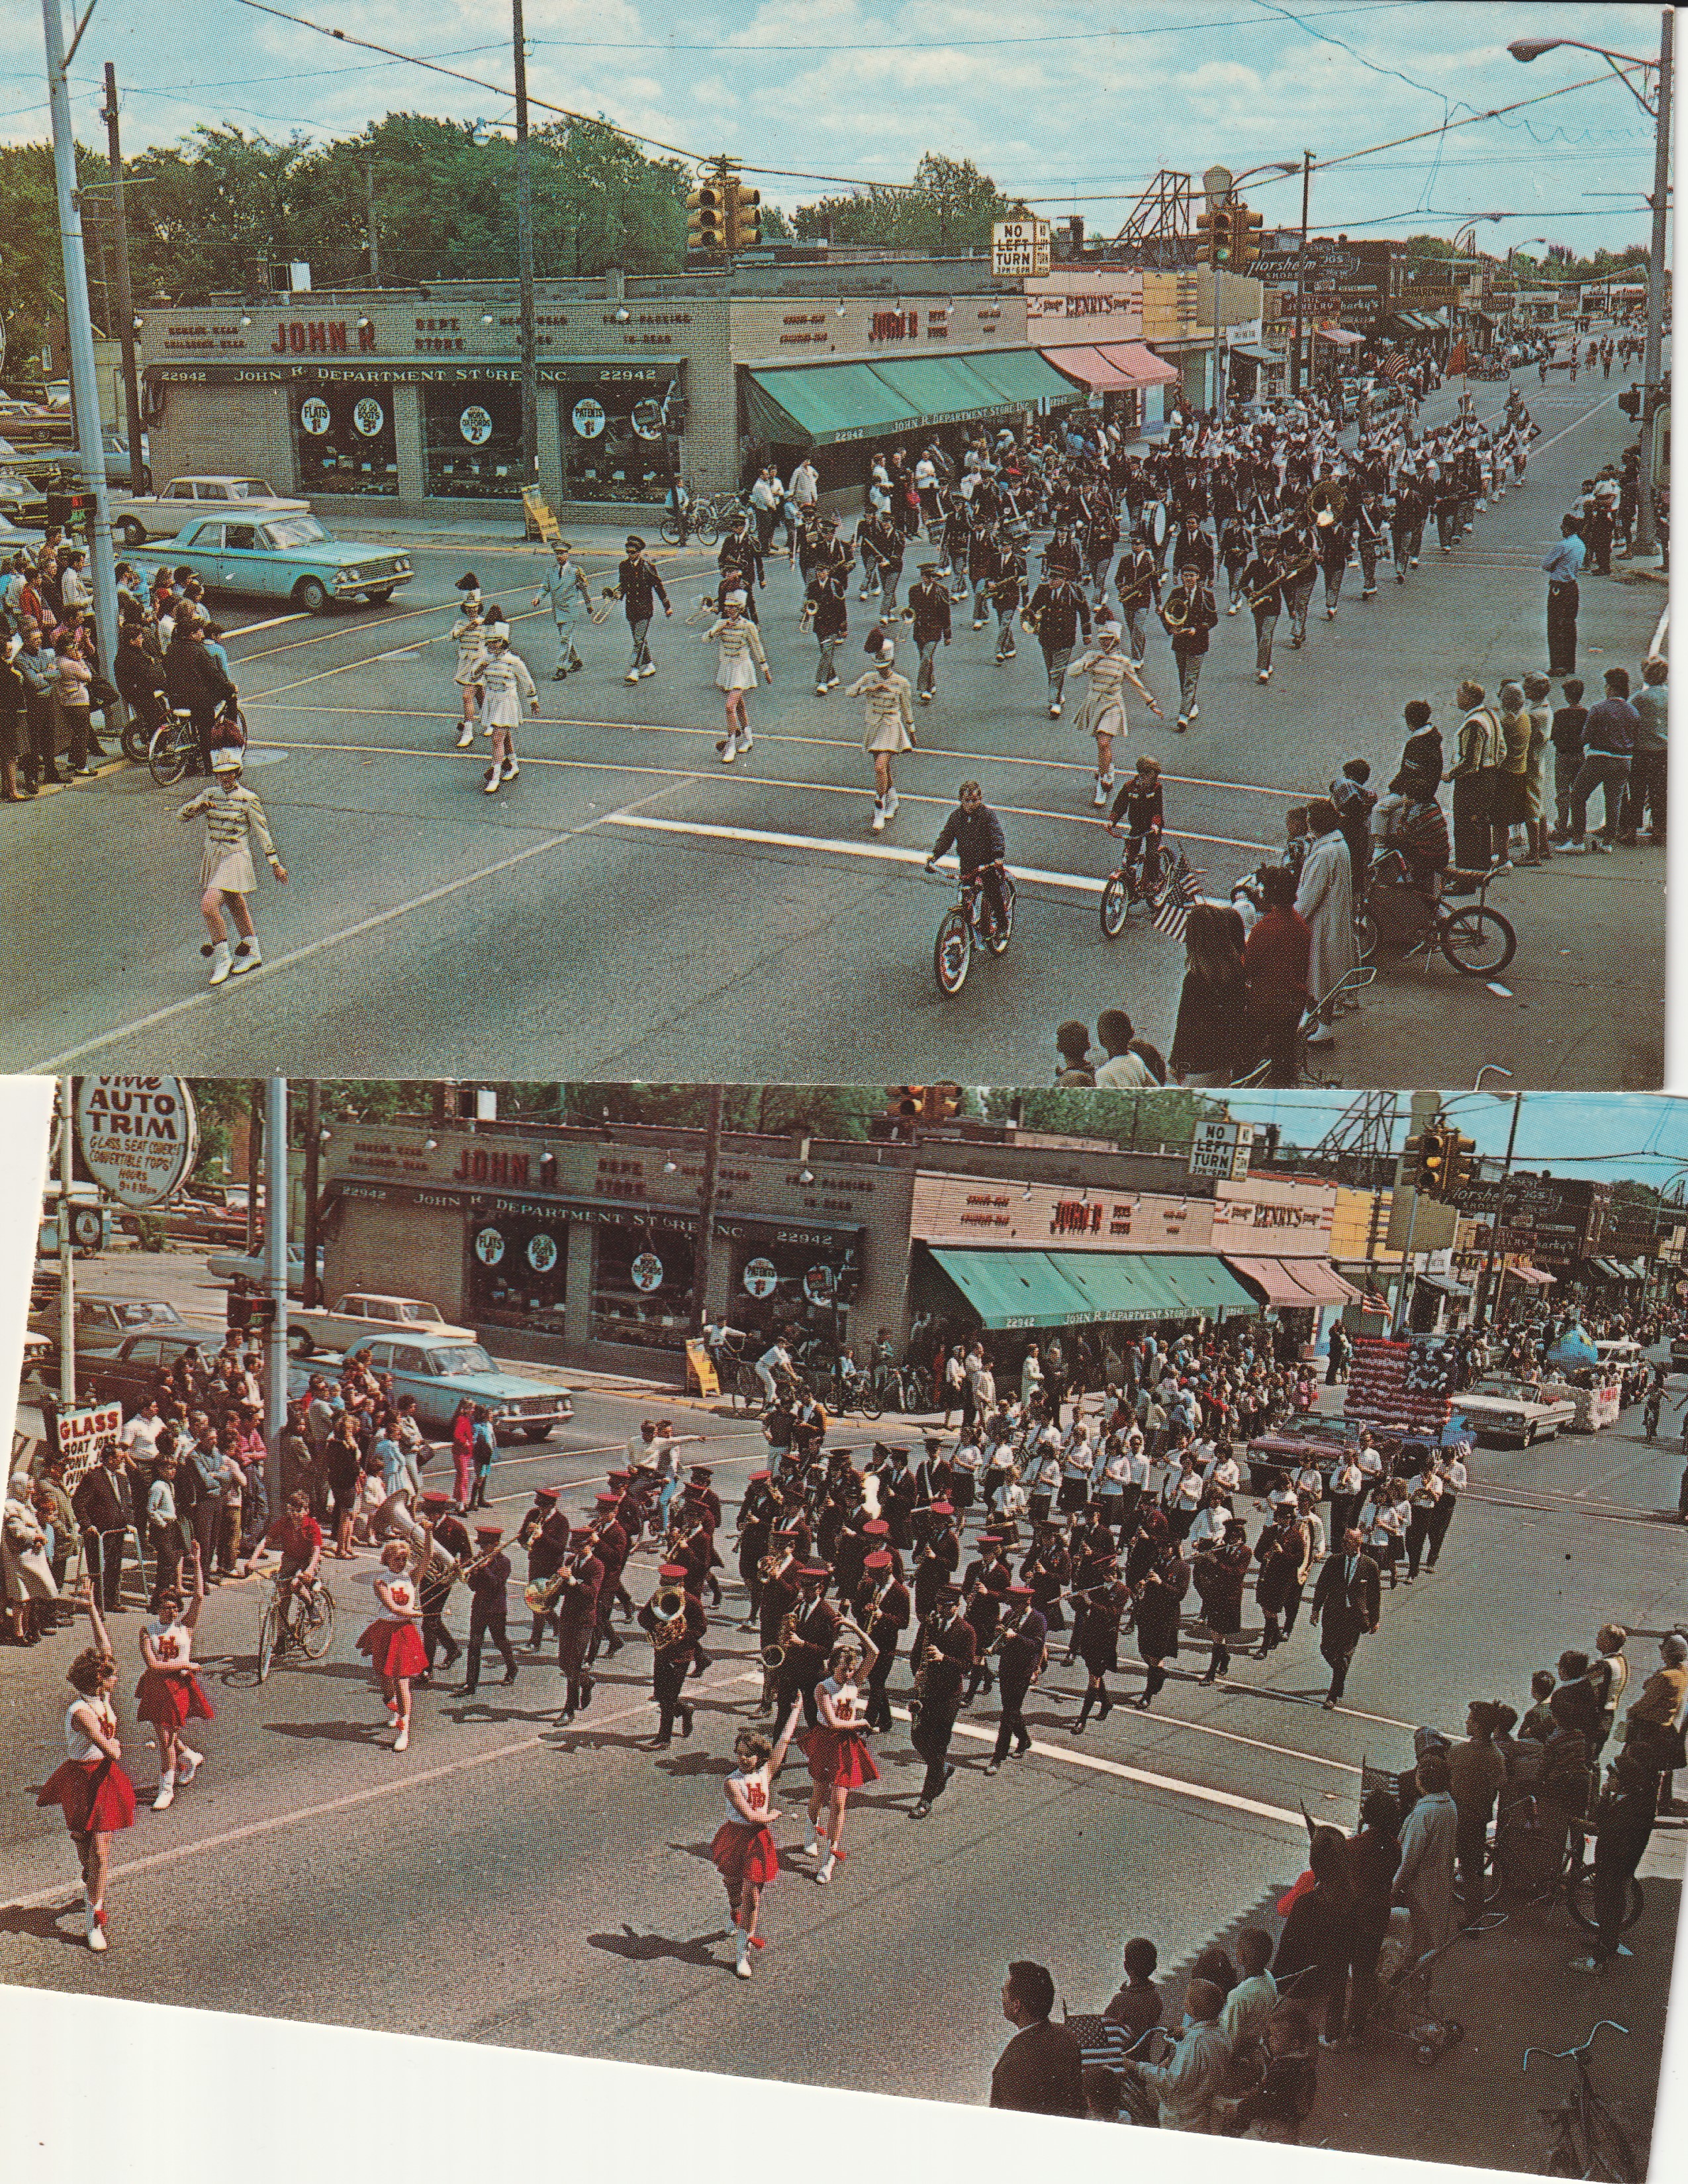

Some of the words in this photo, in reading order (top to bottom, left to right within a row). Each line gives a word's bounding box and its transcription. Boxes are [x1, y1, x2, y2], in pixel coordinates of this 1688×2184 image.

[1004, 224, 1022, 238] NO
[998, 239, 1028, 251] LEFT
[996, 252, 1030, 265] TURN
[271, 321, 347, 353] JOHN
[358, 322, 376, 351] R
[161, 371, 207, 382] 22942
[234, 370, 282, 382] JOHN
[317, 368, 446, 381] DEPARTMENT
[456, 368, 522, 382] STORE
[600, 370, 656, 381] 22942
[305, 406, 328, 418] FLATS
[835, 429, 863, 442] 22942
[892, 420, 918, 433] JOHN
[932, 408, 988, 424] DEPARTMENT
[90, 1089, 175, 1115] AUTO
[86, 1111, 177, 1140] TRIM
[1206, 1126, 1225, 1139] NO
[124, 1139, 148, 1153] SEAT
[1197, 1139, 1230, 1154] LEFT
[89, 1149, 142, 1168] CONVERTIBLE
[453, 1148, 531, 1185] JOHN
[1194, 1153, 1229, 1167] TURN
[414, 1193, 461, 1206] JOHN
[496, 1198, 624, 1224] DEPARTMENT
[633, 1214, 699, 1234] STORE
[776, 1231, 833, 1246] 22942
[1007, 1317, 1035, 1328] 22942
[1064, 1312, 1092, 1324] JOHN
[1105, 1308, 1162, 1322] DEPARTMENT
[59, 1410, 120, 1441] GLASS
